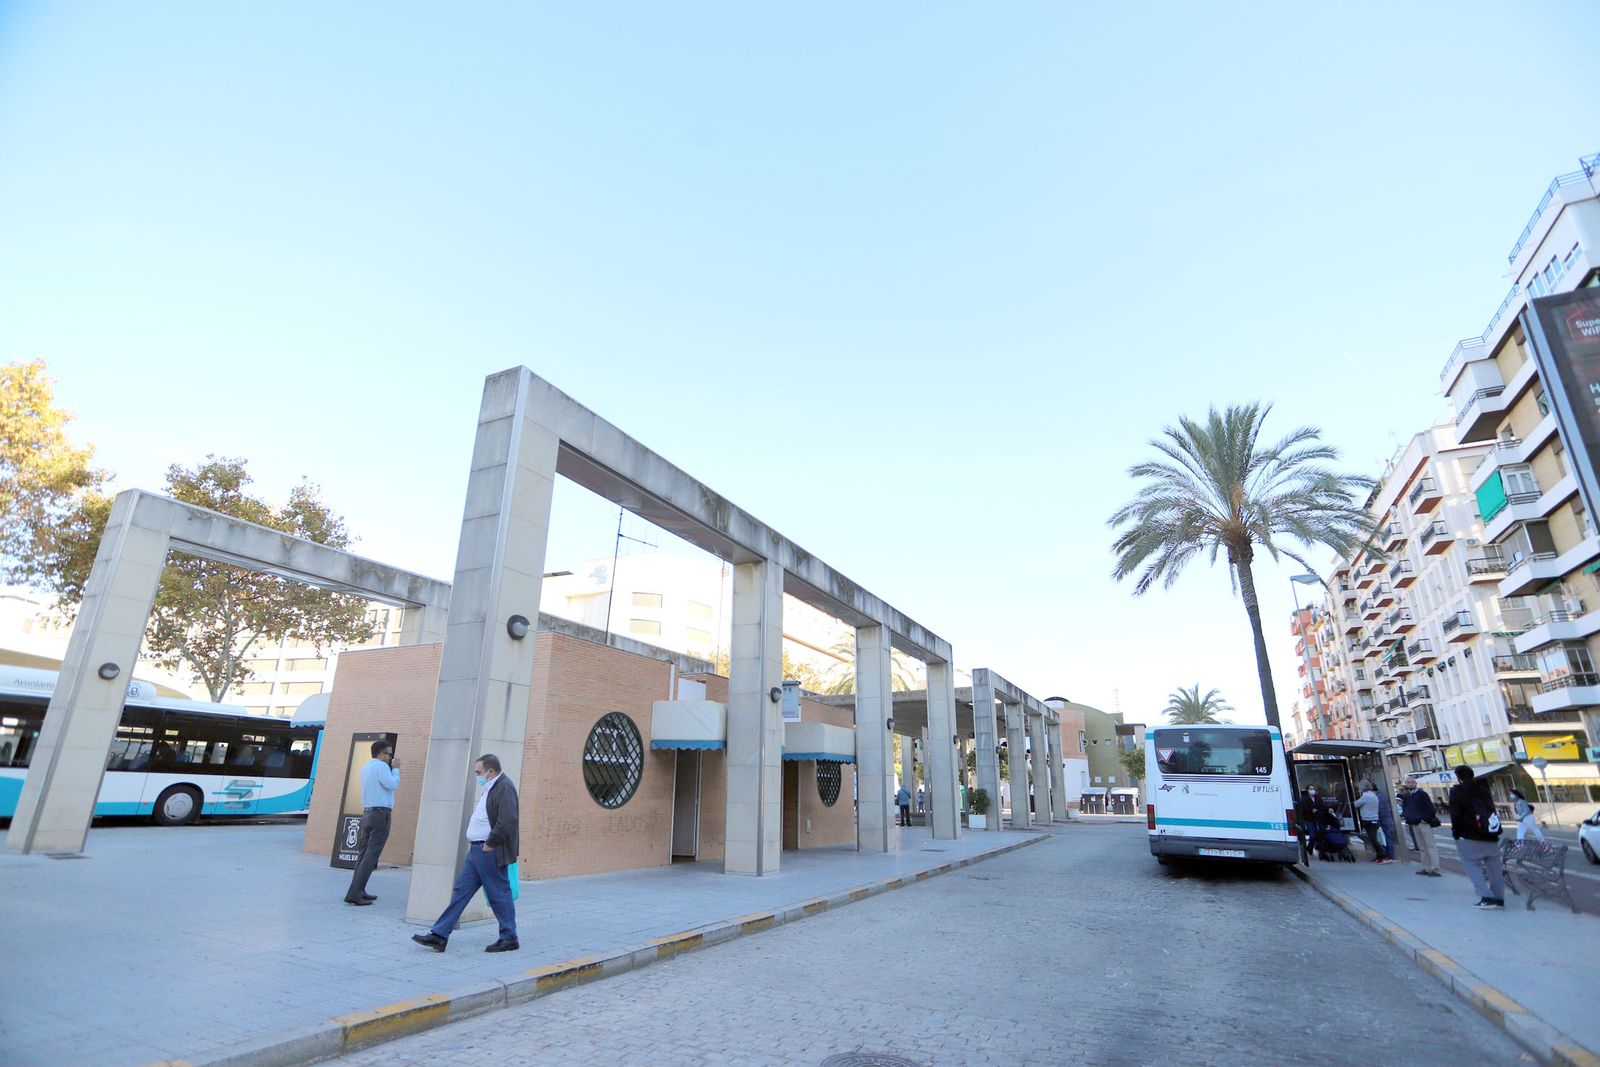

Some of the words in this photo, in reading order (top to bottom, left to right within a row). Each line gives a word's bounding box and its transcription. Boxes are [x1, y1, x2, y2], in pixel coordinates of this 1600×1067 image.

[1576, 319, 1600, 329] Supe
[1255, 766, 1267, 774] 145
[1252, 785, 1280, 793] EMTUSA
[1270, 823, 1284, 831] 145
